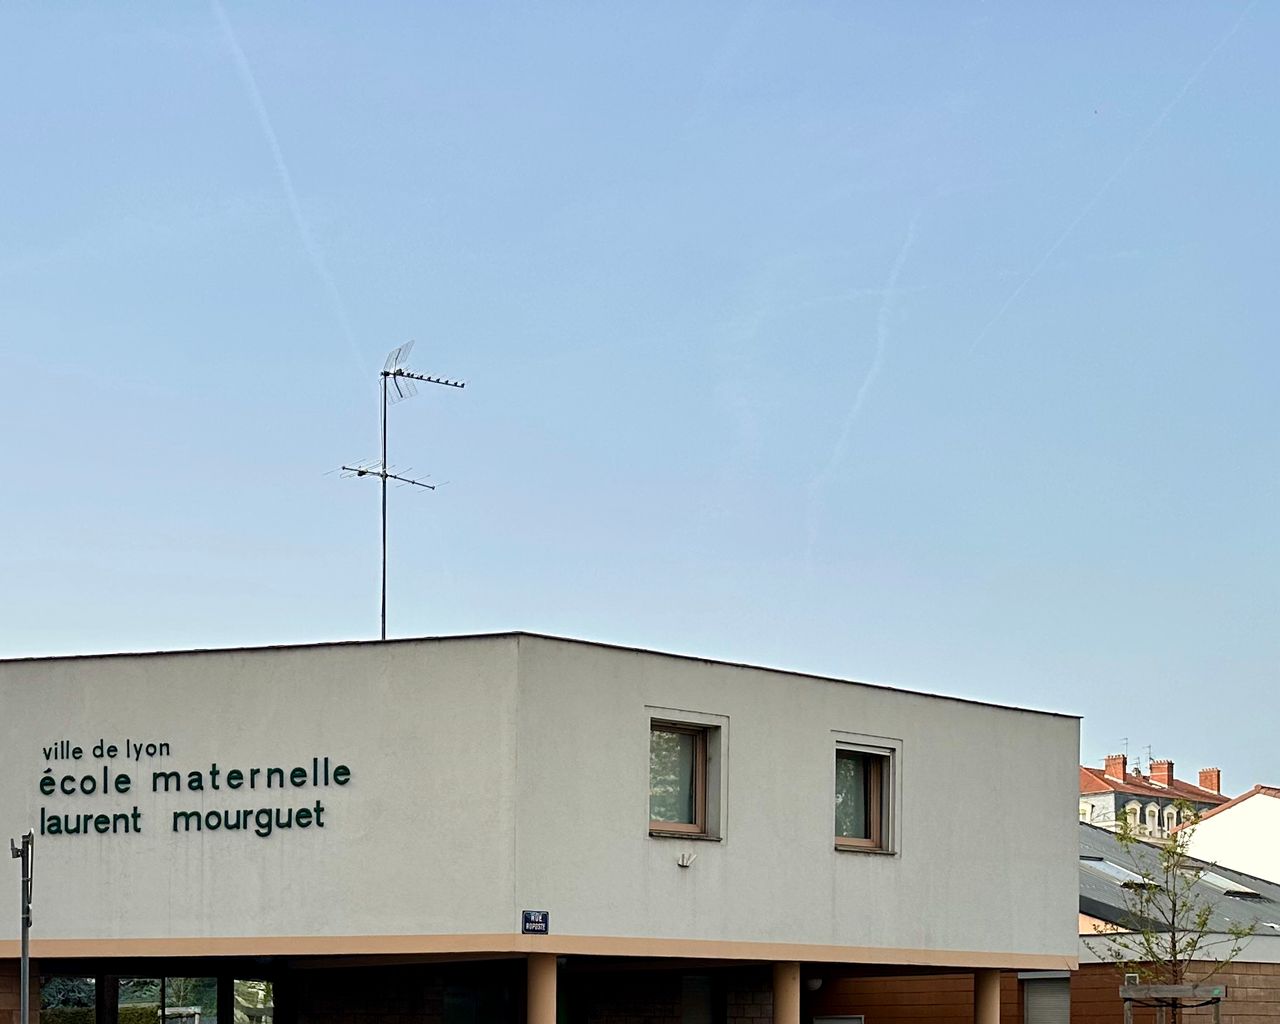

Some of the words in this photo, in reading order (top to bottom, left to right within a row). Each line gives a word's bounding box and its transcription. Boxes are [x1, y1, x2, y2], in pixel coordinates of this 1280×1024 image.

[43, 741, 83, 760] ville
[92, 739, 118, 758] de
[126, 739, 170, 761] lyon
[39, 766, 131, 795] école
[152, 757, 351, 792] maternelle
[40, 806, 142, 835] laurent
[172, 800, 325, 837] mourguet
